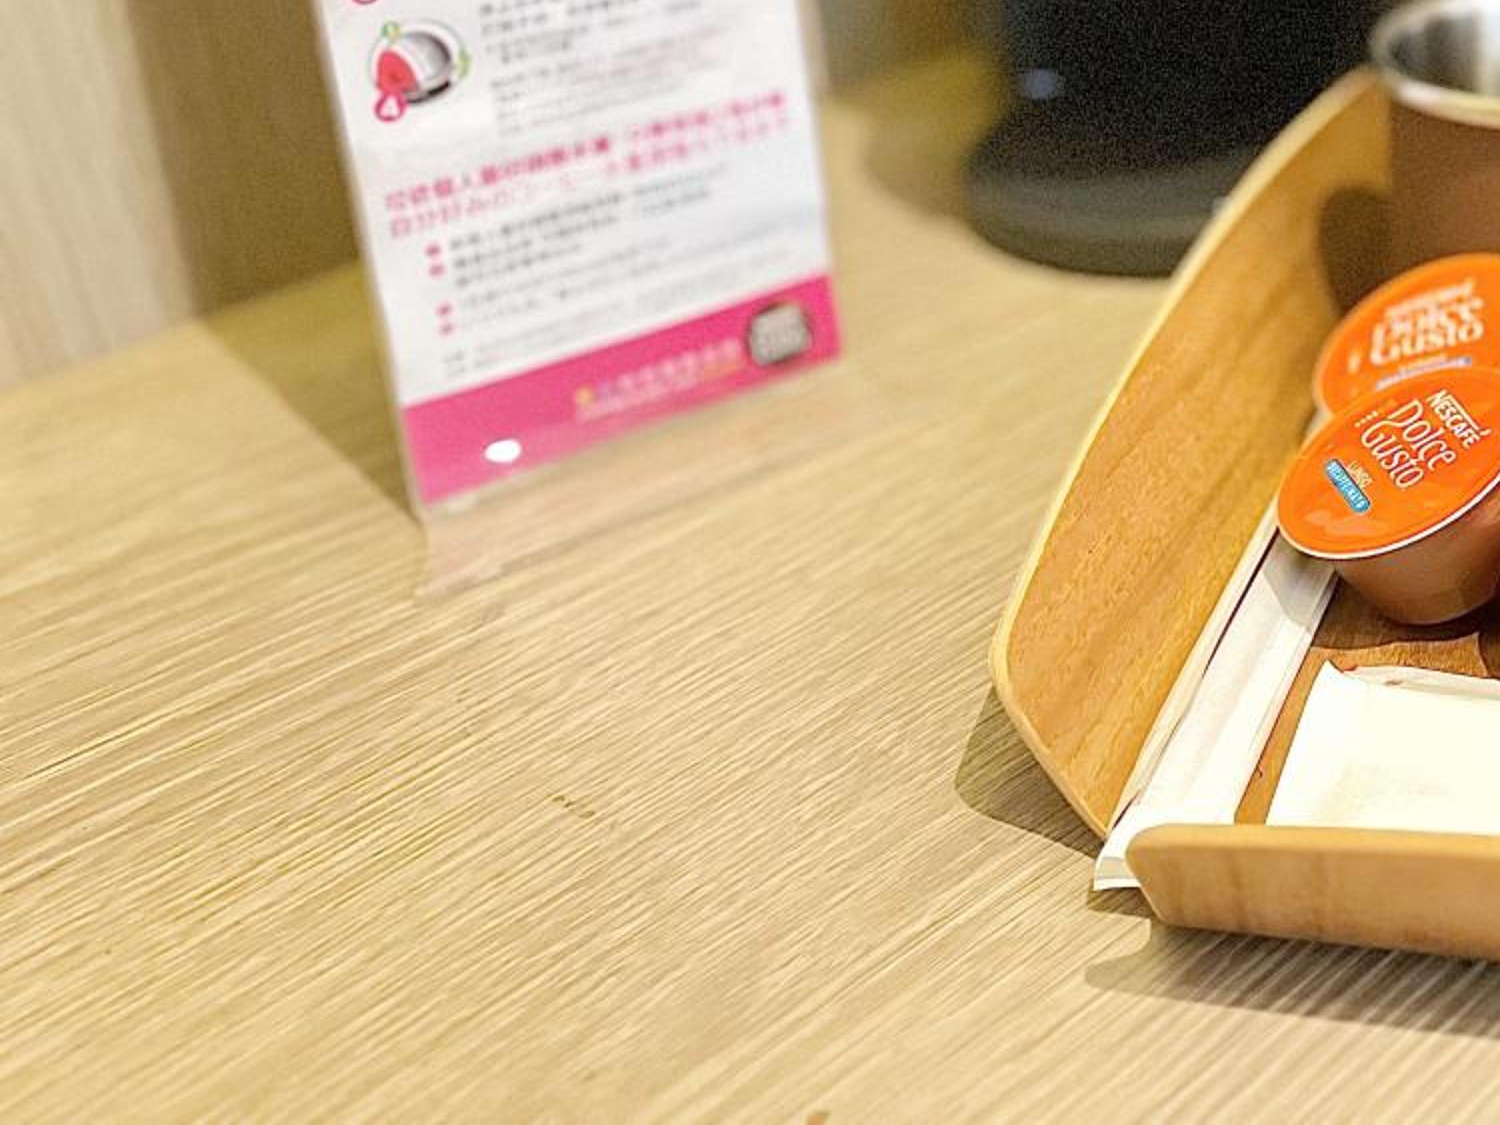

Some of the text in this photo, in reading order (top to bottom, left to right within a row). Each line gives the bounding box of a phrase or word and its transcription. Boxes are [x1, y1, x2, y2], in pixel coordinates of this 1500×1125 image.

[1361, 419, 1425, 489] Gusto
[1386, 399, 1457, 471] Dolce
[1426, 389, 1492, 450] NESCAFÉ
